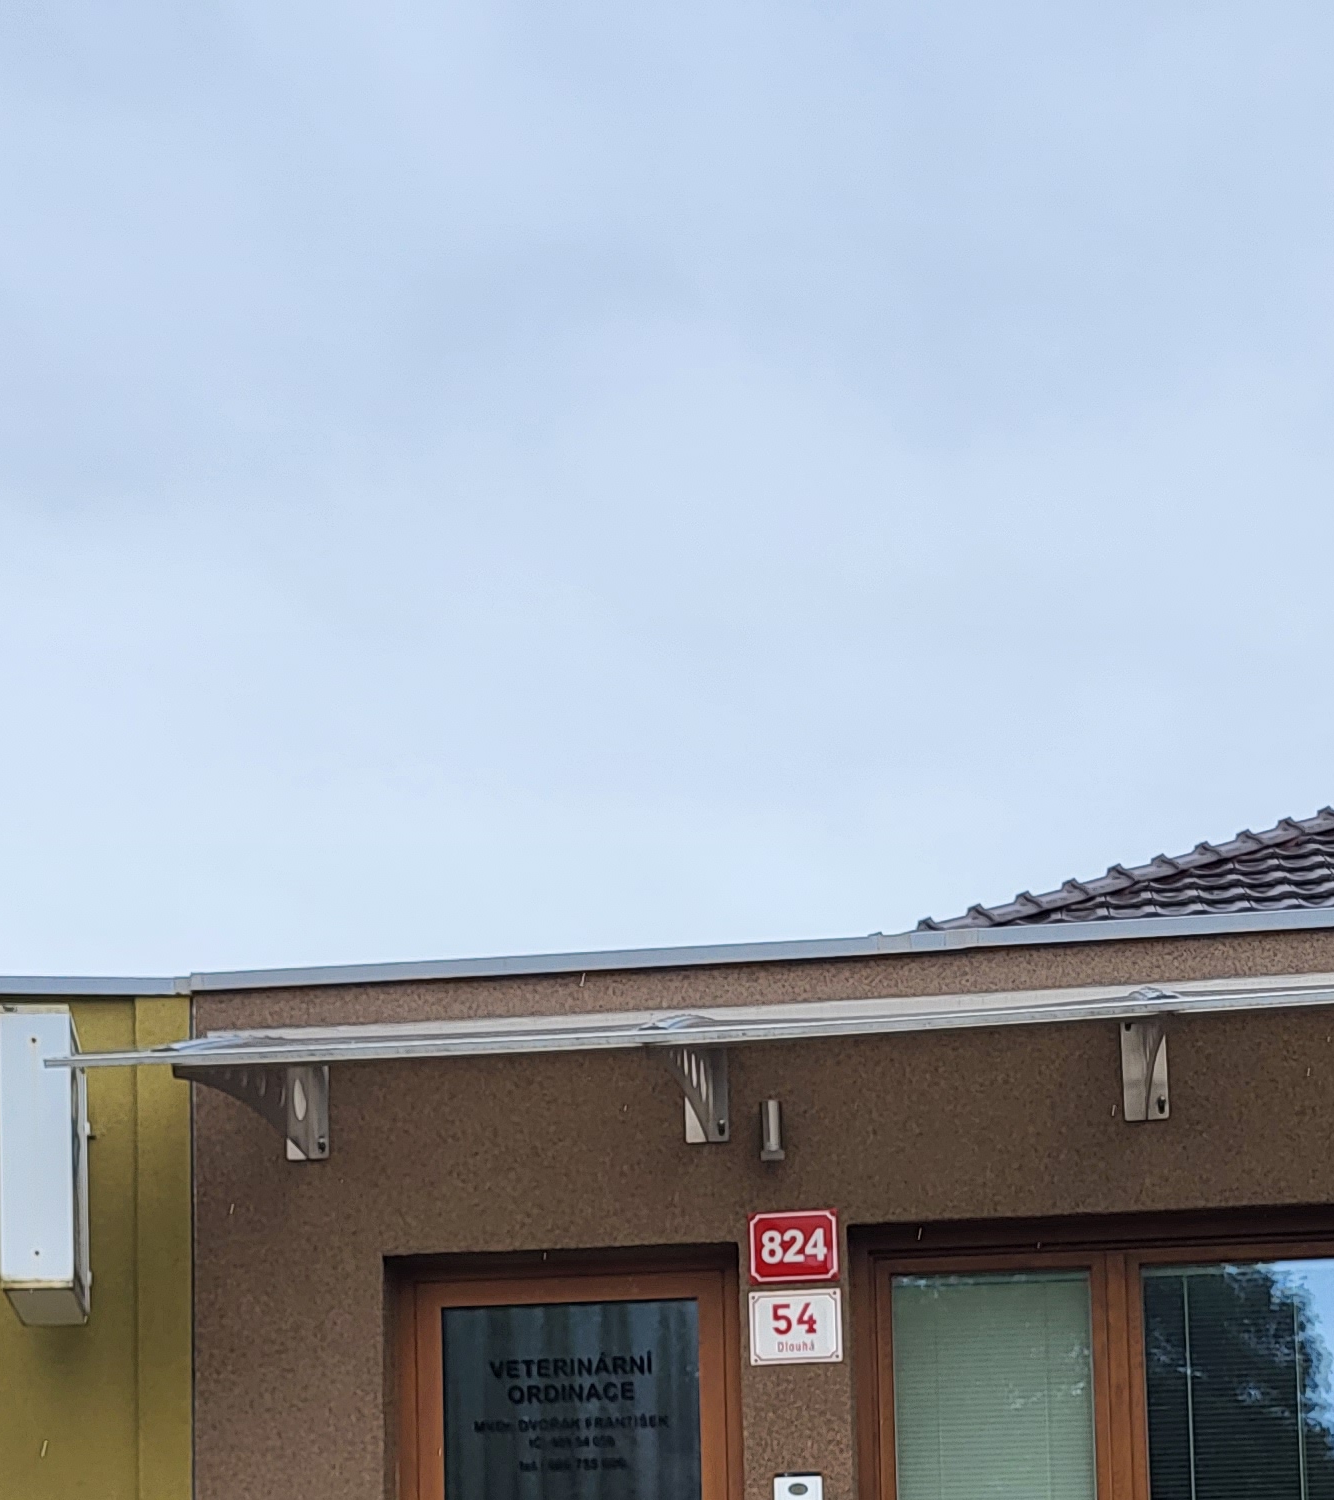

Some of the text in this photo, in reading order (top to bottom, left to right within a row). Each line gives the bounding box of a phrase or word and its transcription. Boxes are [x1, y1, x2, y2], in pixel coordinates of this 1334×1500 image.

[761, 1228, 827, 1264] 824
[771, 1302, 817, 1335] 54
[777, 1339, 815, 1354] Dlouhá
[489, 1351, 653, 1379] VETERINÁRNÍ
[507, 1381, 635, 1405] ORDINACE
[585, 1413, 670, 1429] FRANTIŠEK
